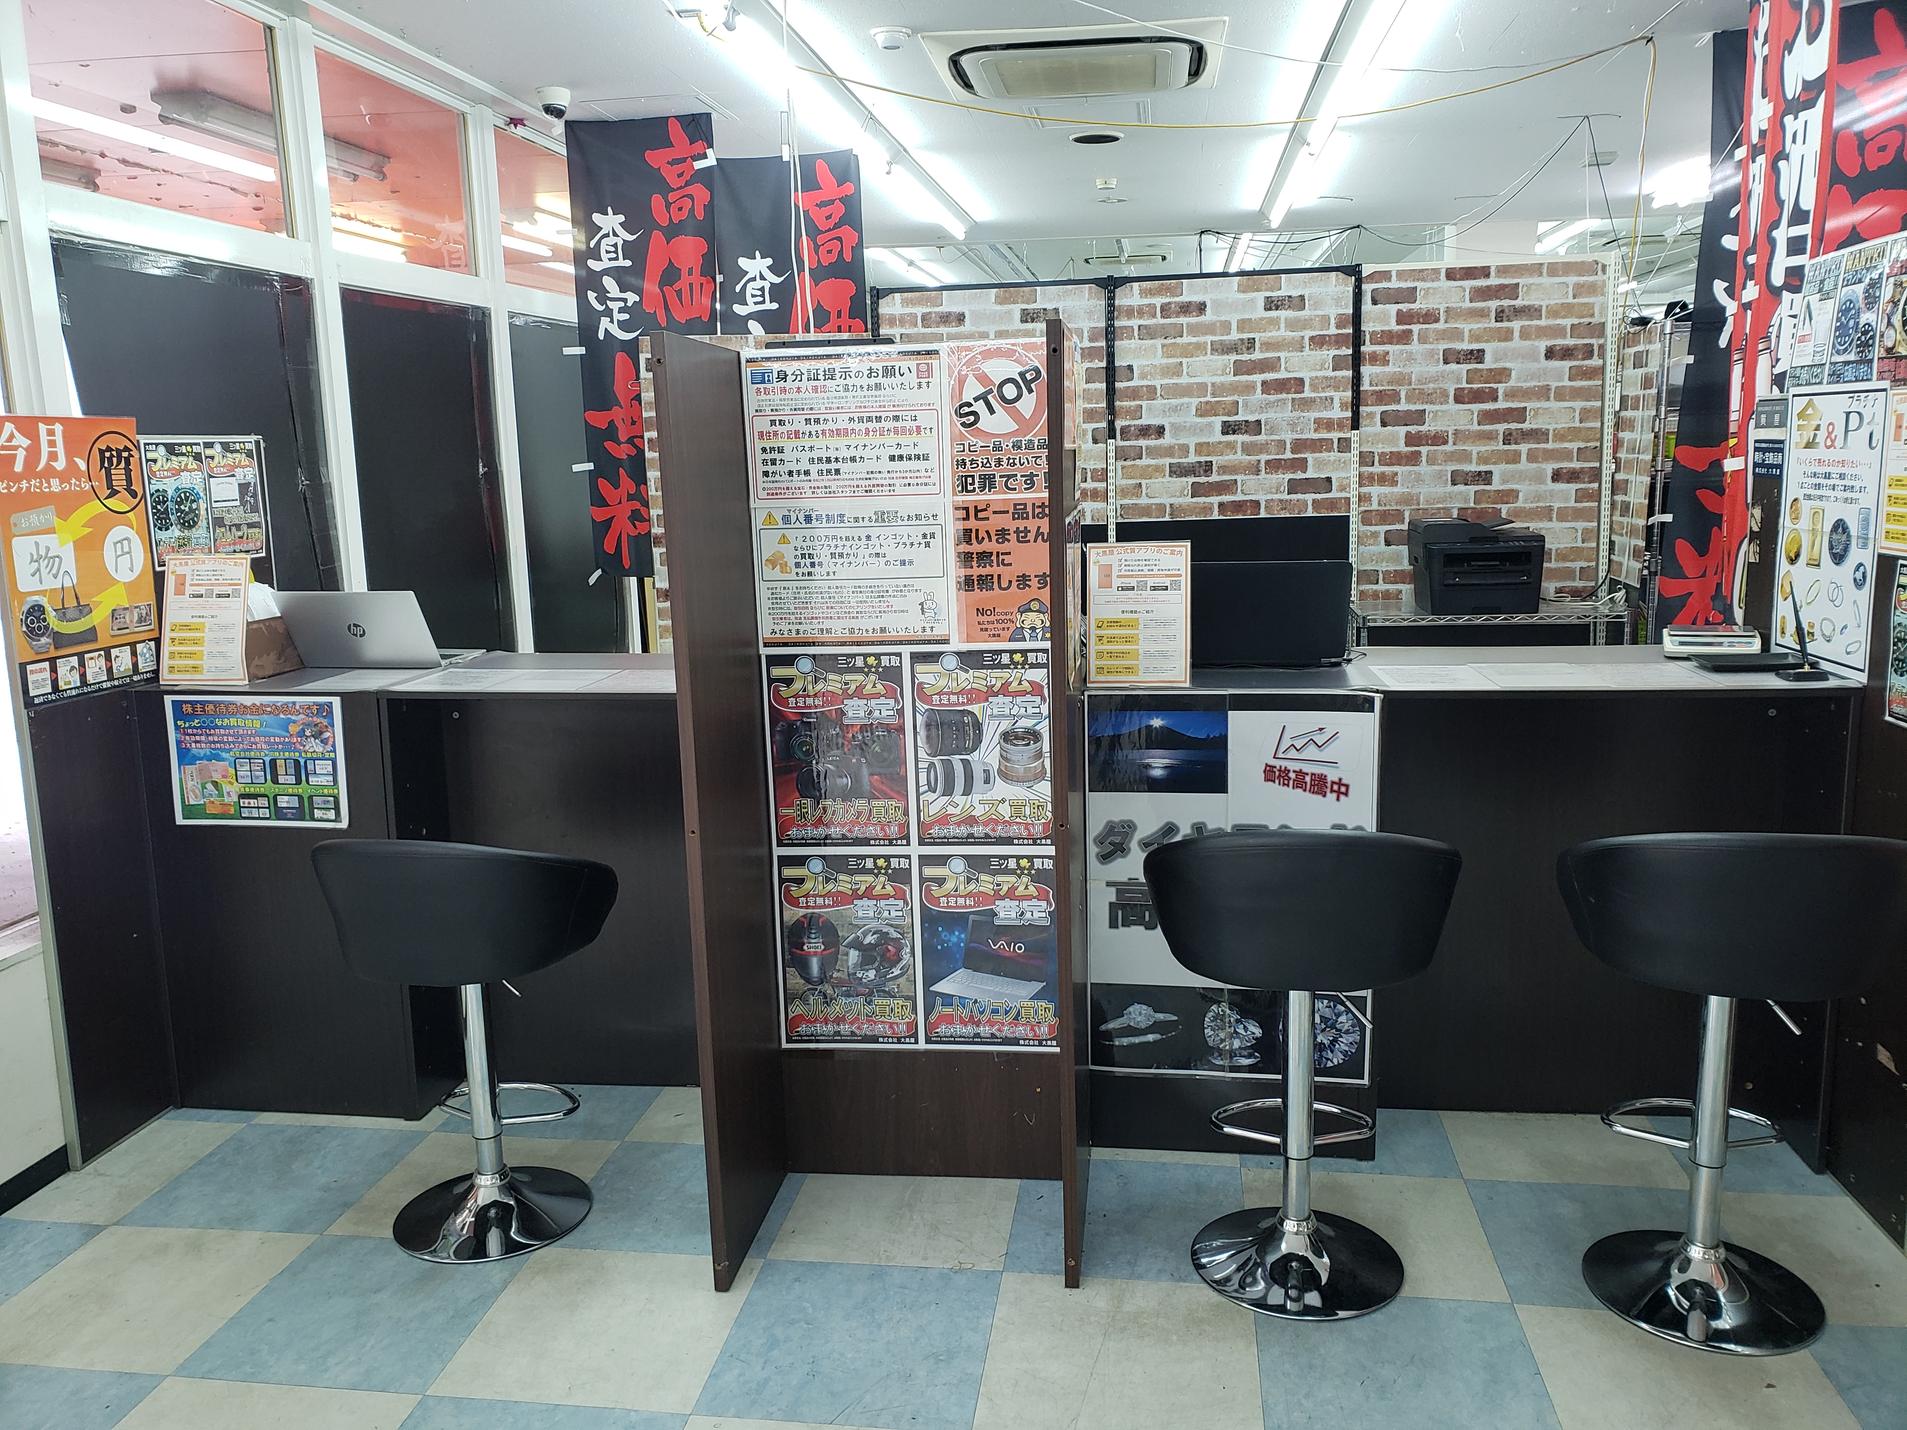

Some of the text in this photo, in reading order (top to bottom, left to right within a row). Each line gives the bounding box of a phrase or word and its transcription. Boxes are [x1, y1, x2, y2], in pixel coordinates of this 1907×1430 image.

[640, 117, 714, 328] 高価
[587, 206, 645, 340] 査定
[775, 364, 913, 384] 身分証提示のお願い
[754, 380, 933, 397] 各取引時の本人確認にご協力をお願いいたします
[954, 364, 1042, 429] STOP
[769, 414, 918, 428] 買取り・質預かり・外貨両替の際には
[757, 426, 934, 441] 現住所の記載がある有効期限内の身分証が毎回必要です
[0, 421, 87, 473] 今月、
[760, 441, 919, 455] 免許証 パスポート マイナンバーカード
[146, 451, 198, 472] プレミアム
[204, 447, 249, 468] プレミアム
[761, 453, 931, 467] 在留カード 住民基本台帳カード 健康保険証
[98, 444, 139, 500] 質
[762, 468, 811, 478] 障がい者手帳
[817, 467, 842, 477] 住民票
[781, 510, 939, 526] 個人番号制度に関する重要なお知らせ
[954, 502, 1049, 521] コピー品は
[864, 533, 873, 543] 金
[875, 531, 936, 542] インゴット・金貨
[956, 526, 1049, 546] 買いません
[29, 540, 63, 585] 物
[113, 536, 134, 574] 円
[956, 550, 1013, 569] 警察に
[795, 570, 838, 578] をお願いします
[957, 572, 1050, 592] 通報します
[350, 623, 364, 638] hp
[769, 625, 936, 637] みなさまのご理解とご協力をお願いいたします
[837, 655, 901, 668] 三ツ星 買取
[983, 652, 1048, 664] 三ツ星 買取
[770, 666, 887, 698] プレミアム
[915, 664, 1034, 695] プレミアム
[843, 697, 899, 725] 査定
[987, 695, 1043, 721] 査定
[1263, 762, 1350, 803] 価格高騰中
[848, 858, 910, 869] 三ツ星 買取
[990, 858, 1054, 869] 三ツ星 買取
[782, 866, 897, 898] プレミアム
[922, 866, 1040, 898] プレミアム
[852, 897, 907, 924] 査定
[993, 899, 1051, 926] 査定
[988, 938, 1025, 953] VAIO
